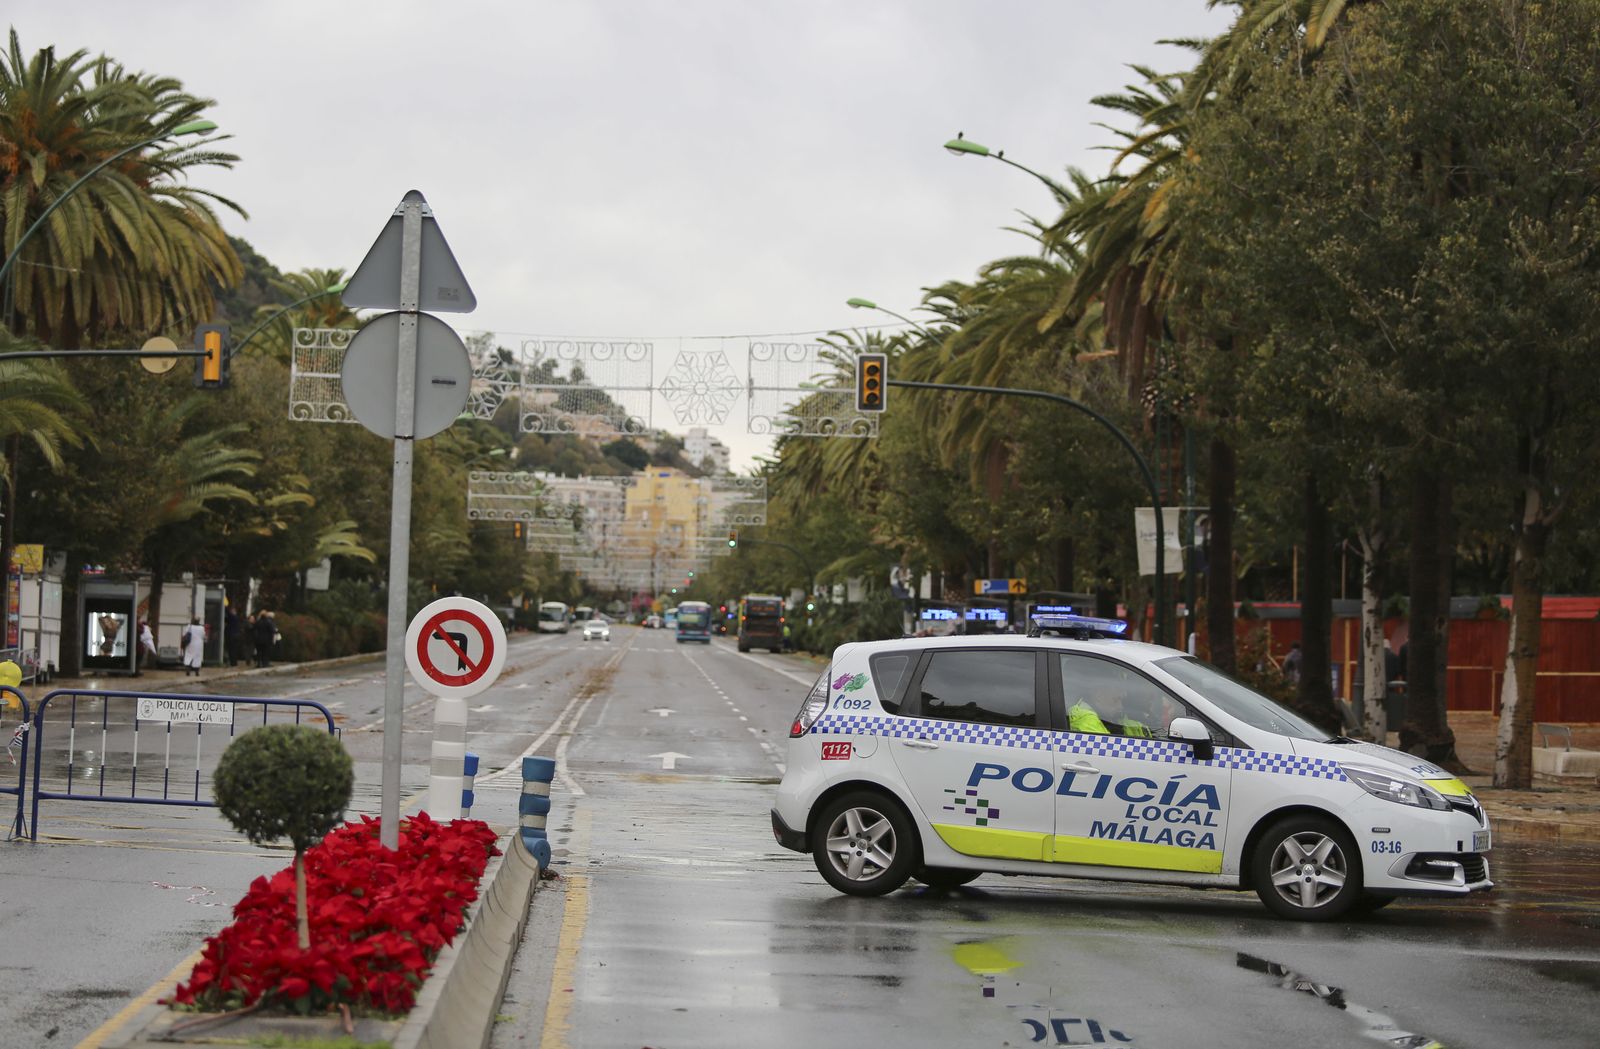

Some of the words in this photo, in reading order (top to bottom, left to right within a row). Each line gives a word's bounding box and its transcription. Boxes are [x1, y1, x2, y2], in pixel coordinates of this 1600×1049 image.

[981, 580, 992, 593] P
[156, 700, 194, 711] POLICIA
[197, 702, 228, 713] LOCAL
[843, 699, 872, 710] 092
[828, 744, 850, 755] 112
[967, 762, 1221, 811] POLICÍA
[1125, 804, 1218, 827] LOCAL
[1089, 820, 1216, 850] MÁLAGA
[1371, 841, 1402, 853] 03-16
